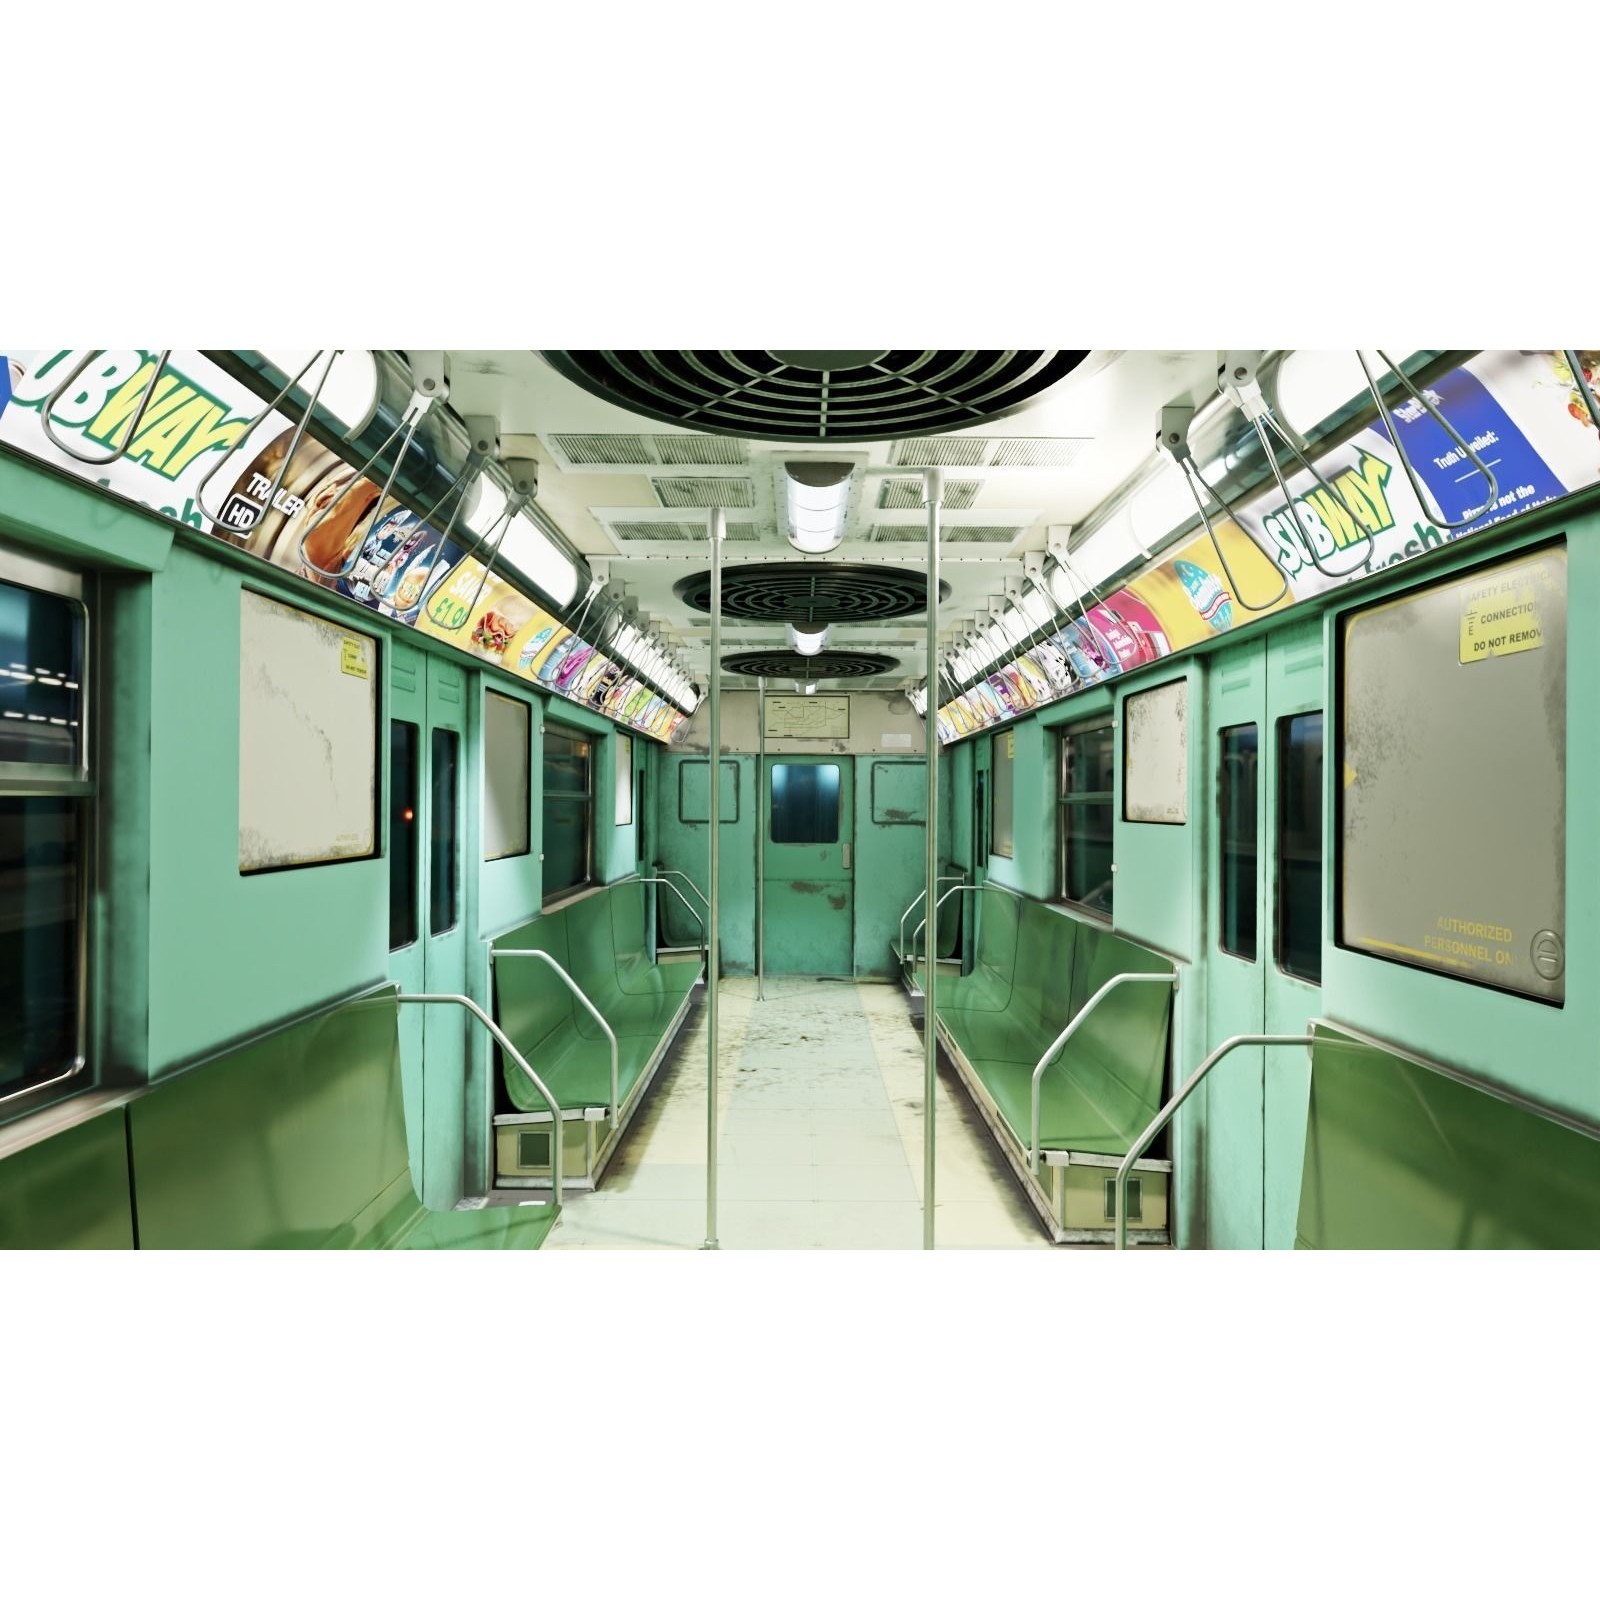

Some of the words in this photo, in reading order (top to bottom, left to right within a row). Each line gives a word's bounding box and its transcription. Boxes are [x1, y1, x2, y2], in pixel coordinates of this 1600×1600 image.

[1433, 451, 1461, 470] Truth
[1454, 430, 1500, 459] Uveiled:
[1498, 490, 1517, 507] not
[1515, 484, 1536, 500] the
[227, 503, 255, 528] HD
[1262, 443, 1396, 582] SUBWAY
[1470, 585, 1498, 601] AFETY
[1473, 641, 1486, 652] DO
[1488, 636, 1507, 649] NOT
[1509, 628, 1542, 644] REMOV
[1436, 916, 1513, 943] AUTHORIZED
[1424, 934, 1493, 962] PERSONNEL
